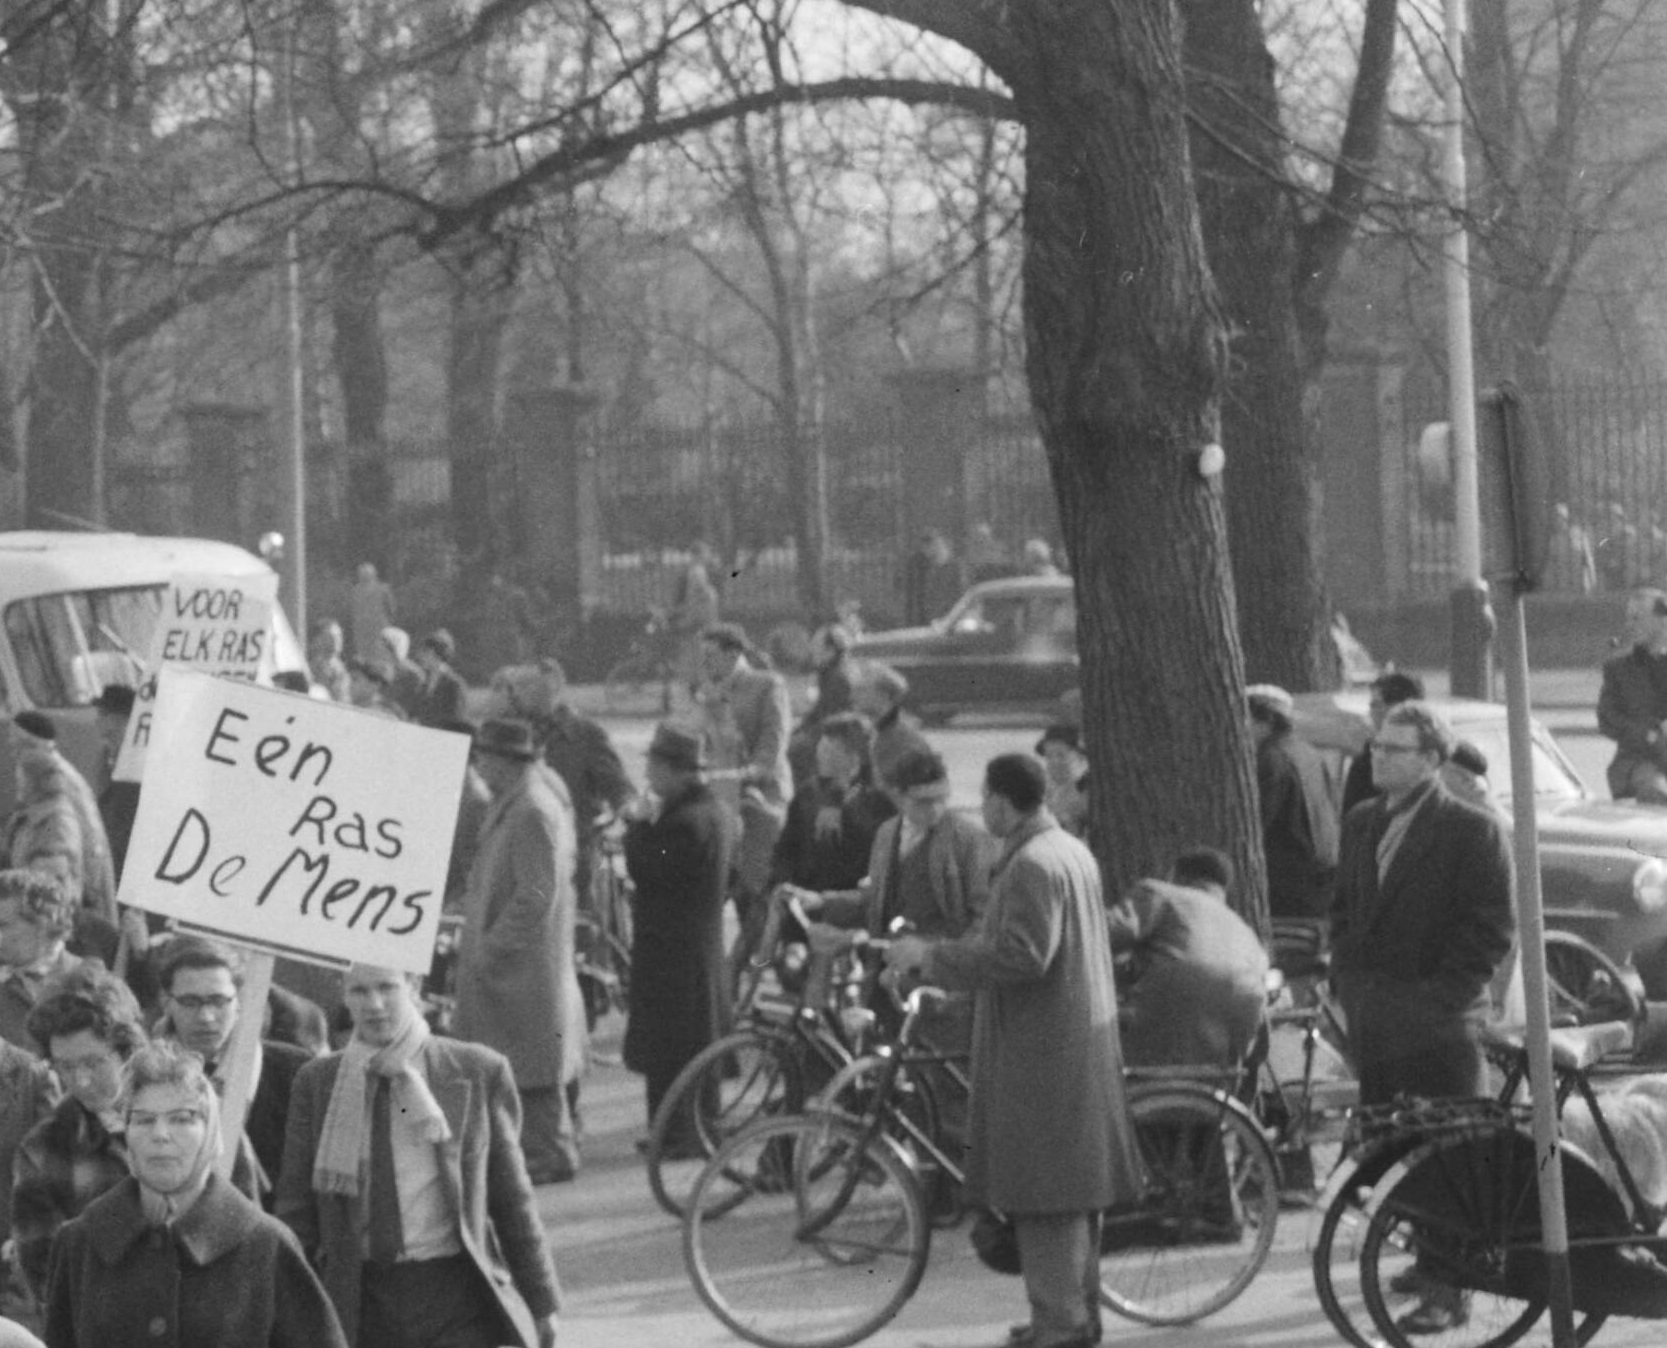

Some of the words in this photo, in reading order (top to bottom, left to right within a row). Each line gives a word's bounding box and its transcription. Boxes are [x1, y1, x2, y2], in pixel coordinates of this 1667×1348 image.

[175, 588, 244, 620] VOOR
[162, 628, 214, 661] ELK
[218, 629, 266, 663] RAS
[287, 795, 403, 860] Ras
[154, 807, 247, 898] De
[255, 846, 434, 935] Mens
